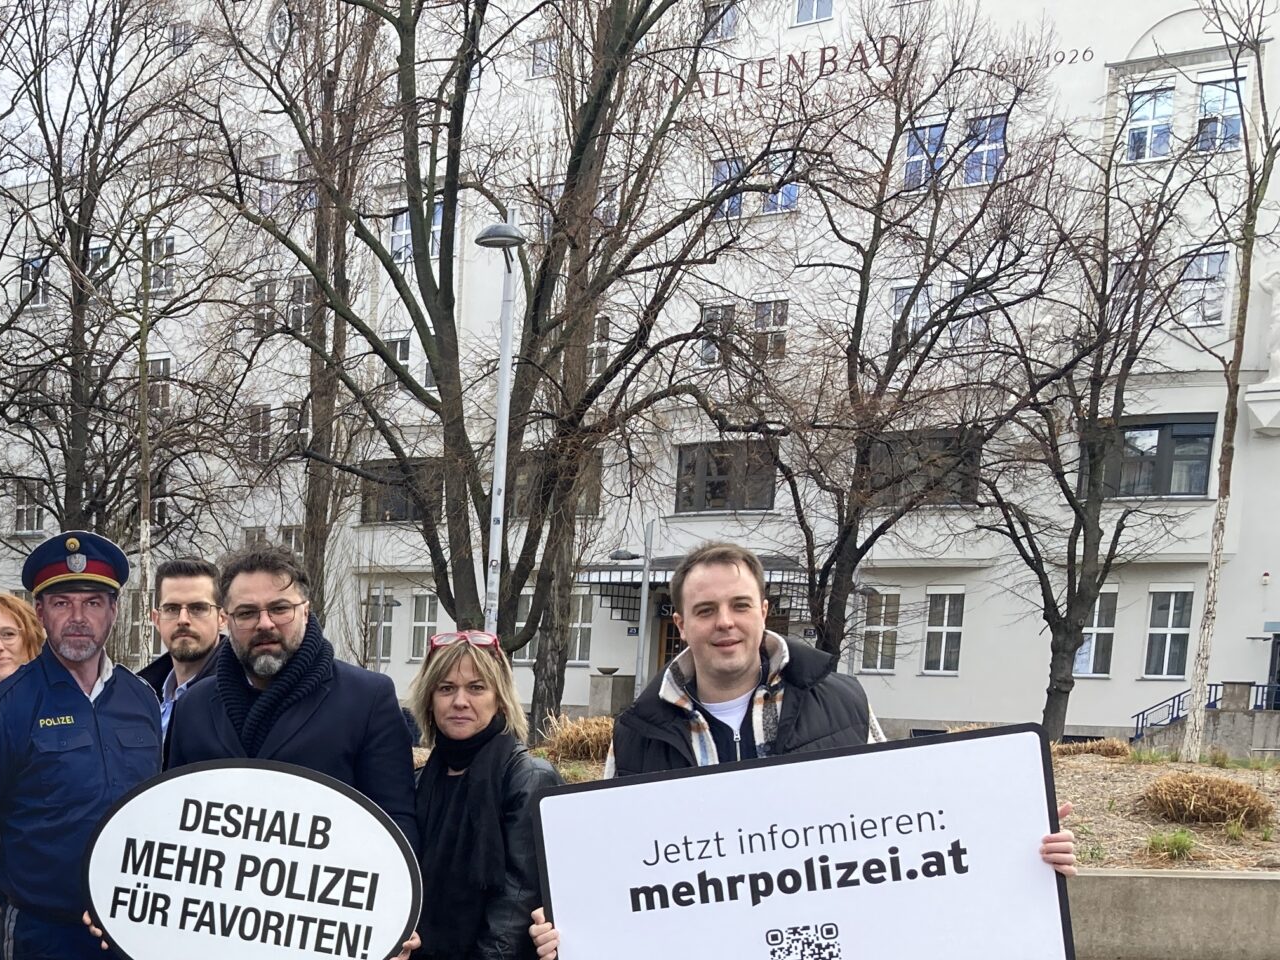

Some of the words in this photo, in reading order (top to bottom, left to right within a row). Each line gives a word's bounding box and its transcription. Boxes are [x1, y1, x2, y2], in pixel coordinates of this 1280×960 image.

[39, 715, 75, 728] POLIZEI
[179, 798, 332, 850] DESHALB
[642, 831, 726, 867] Jetzt
[738, 808, 947, 855] informieren:
[120, 837, 226, 889] MEHR
[235, 854, 380, 912] POLIZEI
[629, 839, 969, 912] mehrpolizei.at
[110, 882, 172, 927] FÜR
[179, 897, 374, 960] FAVORITEN!
